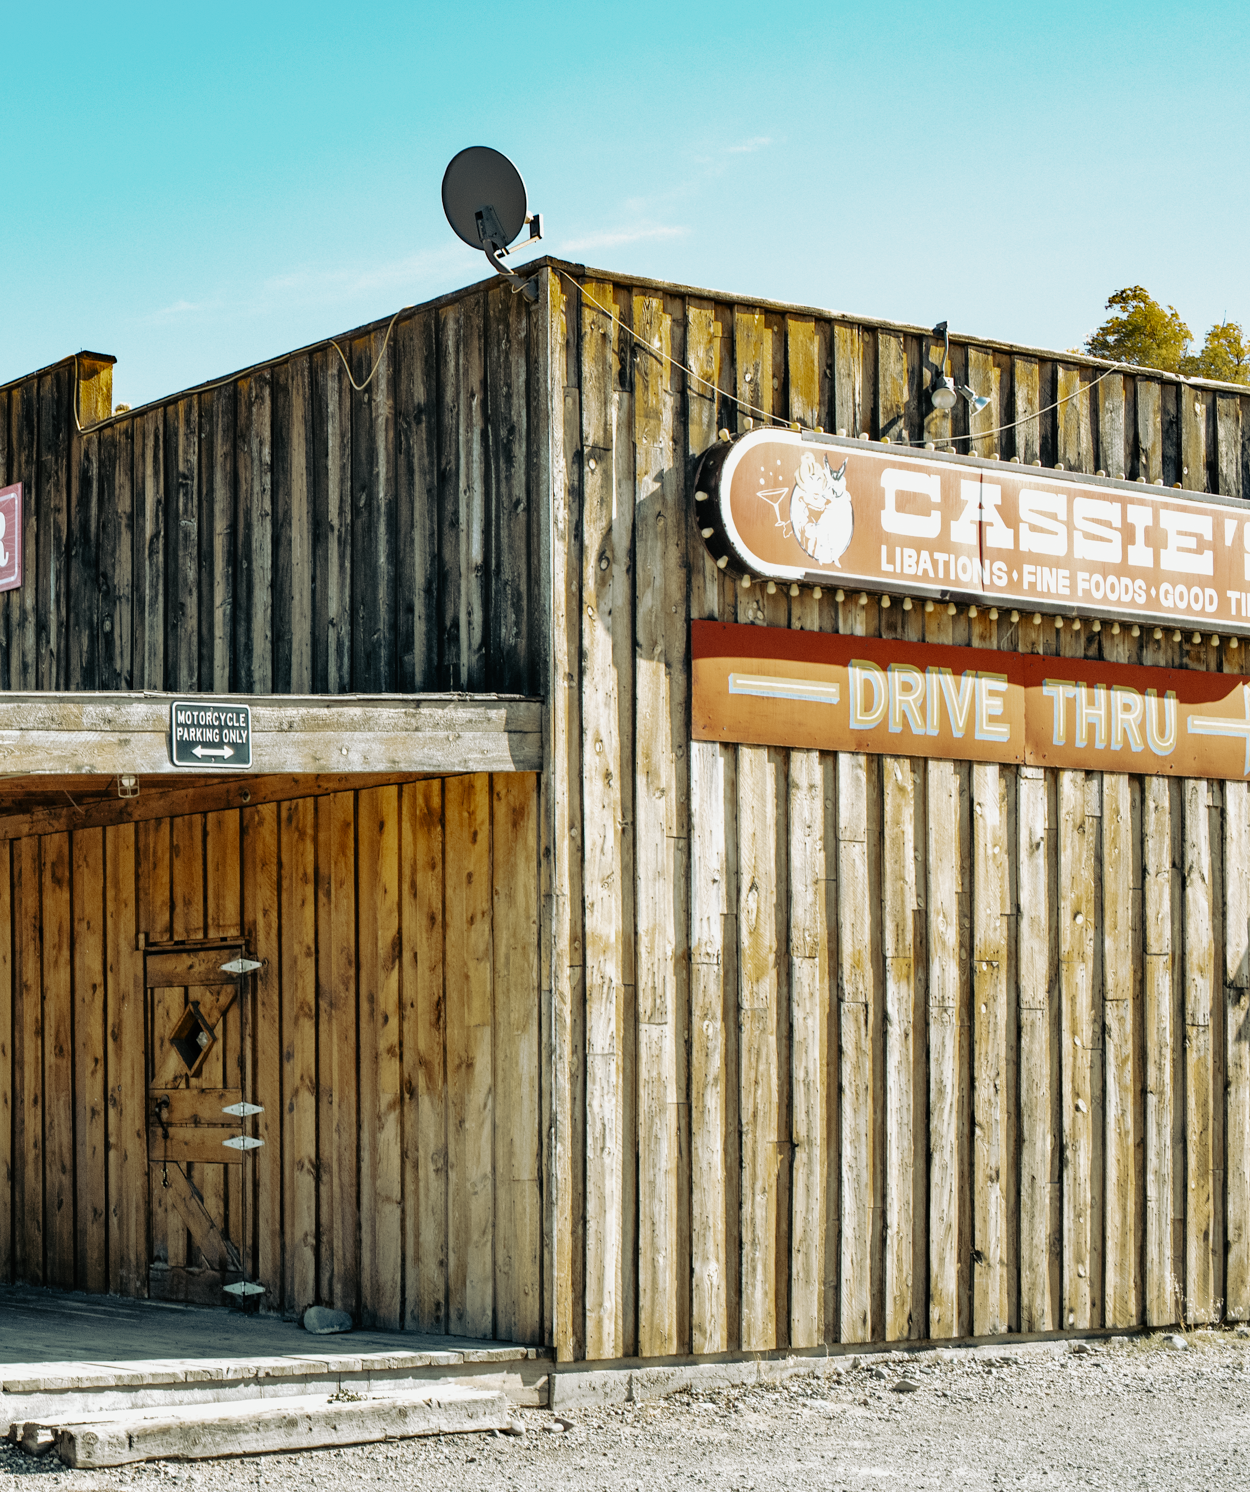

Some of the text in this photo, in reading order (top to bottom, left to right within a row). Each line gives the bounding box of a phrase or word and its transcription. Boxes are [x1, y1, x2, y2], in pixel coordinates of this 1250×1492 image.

[880, 467, 1250, 581] CASSIE'
[881, 544, 1250, 617] LIBATIONS FINE FOODS GOOD TI
[176, 727, 248, 743] PARKING ONLY
[177, 710, 246, 727] MOTORCYCLE
[848, 658, 1178, 756] DRIVE THRU
